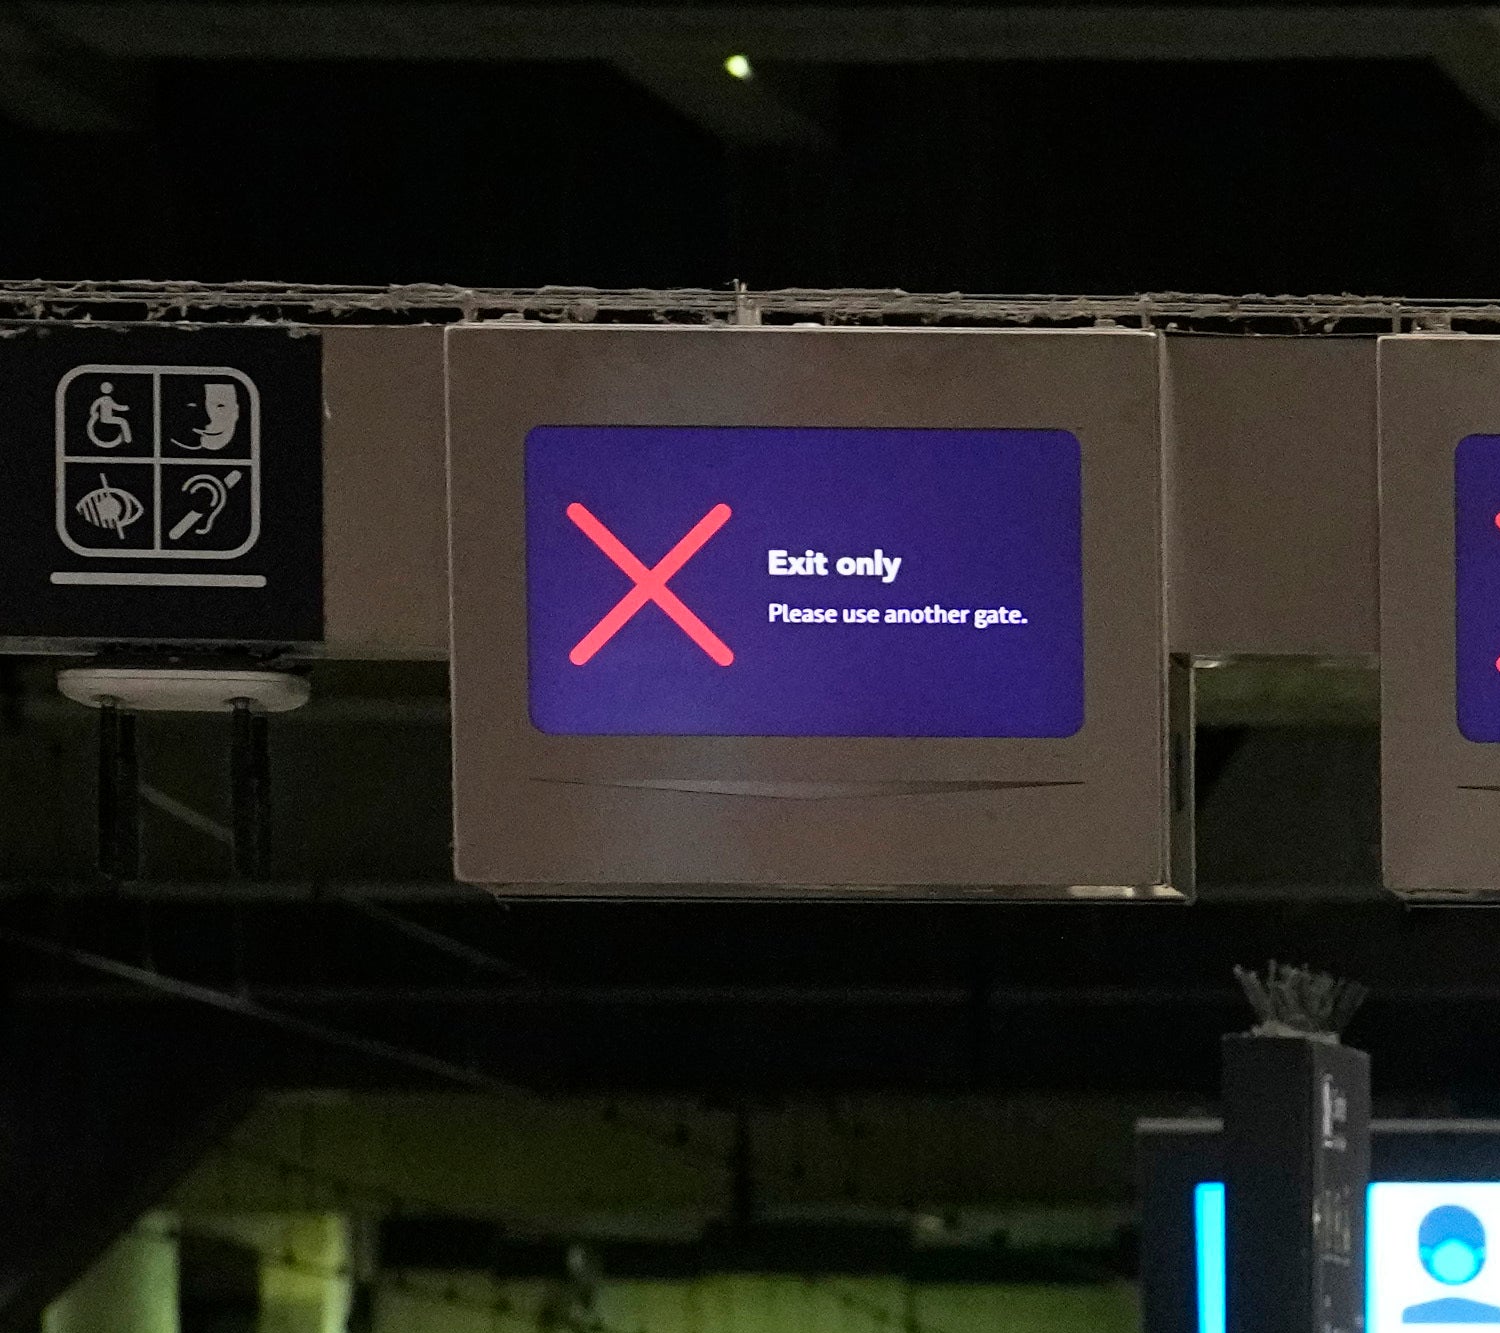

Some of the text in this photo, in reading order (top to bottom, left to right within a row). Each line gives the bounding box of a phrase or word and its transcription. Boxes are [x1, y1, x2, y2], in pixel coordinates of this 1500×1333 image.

[769, 549, 901, 583] Exit only
[769, 604, 1028, 629] Please use another gate.
